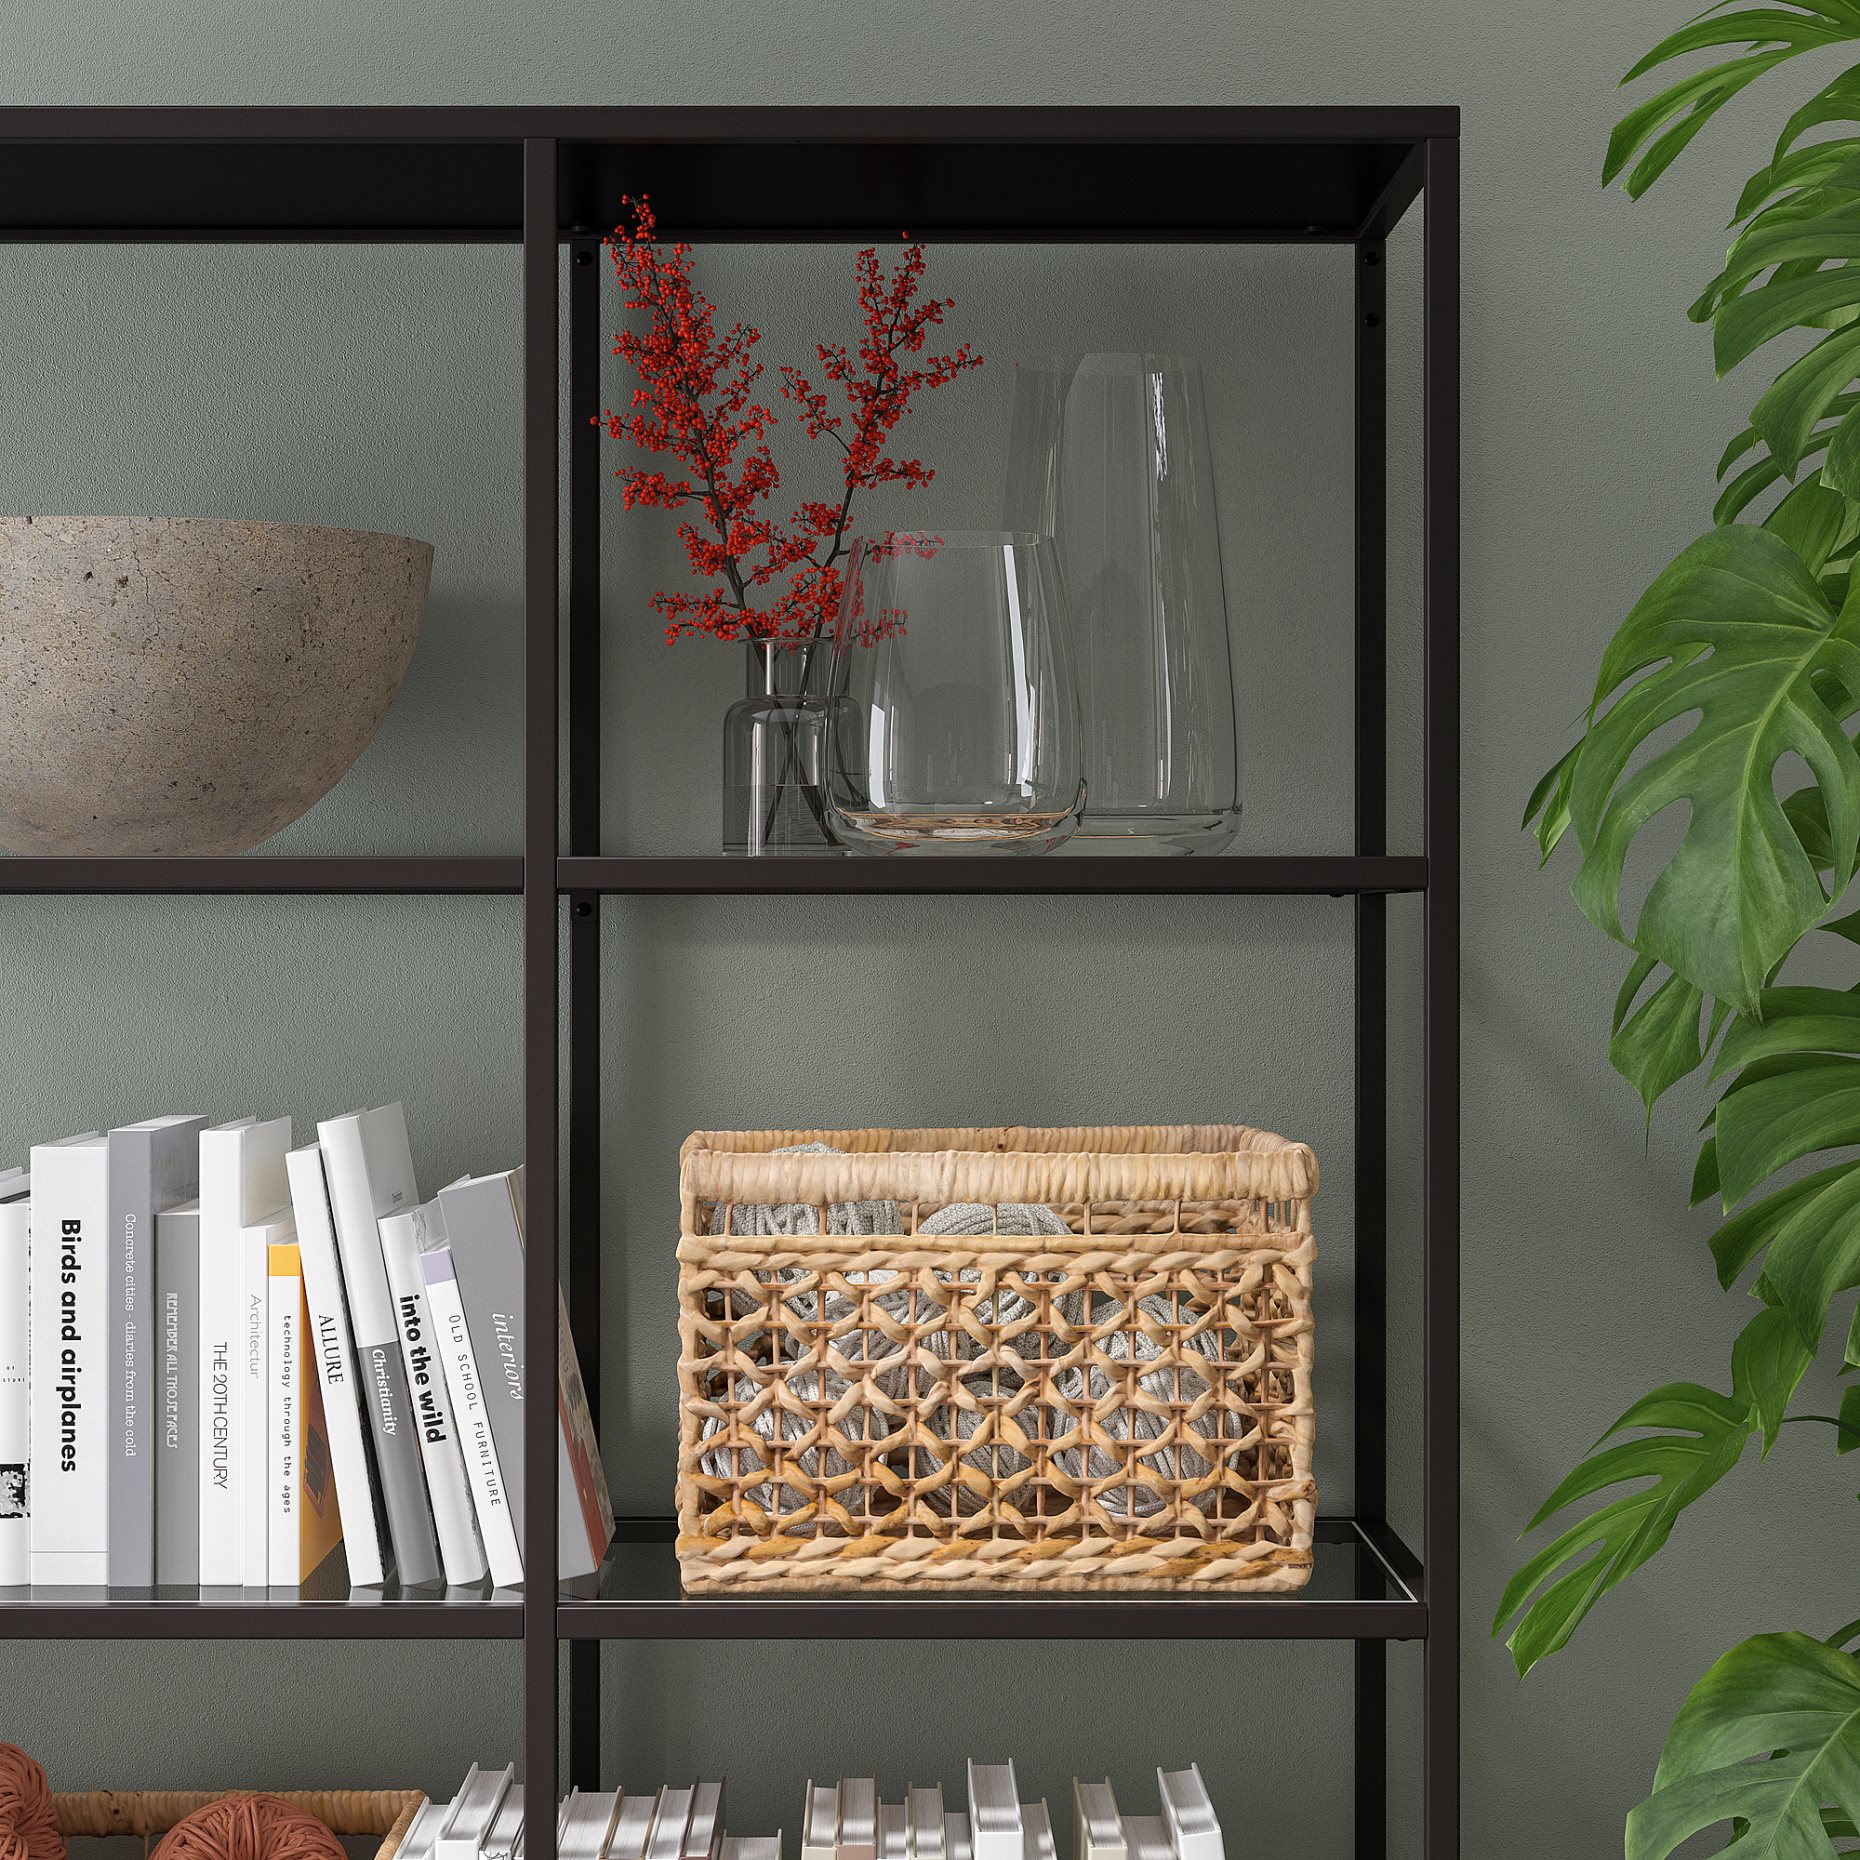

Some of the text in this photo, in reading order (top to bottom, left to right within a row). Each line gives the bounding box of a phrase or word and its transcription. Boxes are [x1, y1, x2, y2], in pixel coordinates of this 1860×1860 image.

[125, 1213, 137, 1272] Concrete
[125, 1275, 137, 1311] cities
[55, 1218, 82, 1472] Birds and airplanes
[125, 1321, 137, 1367] diaries
[166, 1292, 178, 1449] REMEMBER ALL THOSE FACES
[250, 1294, 262, 1379] Architectur
[318, 1314, 344, 1384] ALLURE
[399, 1294, 447, 1443] into the wild
[492, 1313, 525, 1400] interiors
[125, 1370, 137, 1403] from
[125, 1404, 137, 1426] the
[213, 1341, 228, 1489] THE 20TH CENTURY
[281, 1315, 292, 1513] technology through the ages
[372, 1349, 396, 1436] Christianity
[448, 1314, 501, 1507] OLD SCHOOL FURNITURE
[125, 1428, 137, 1457] cold
